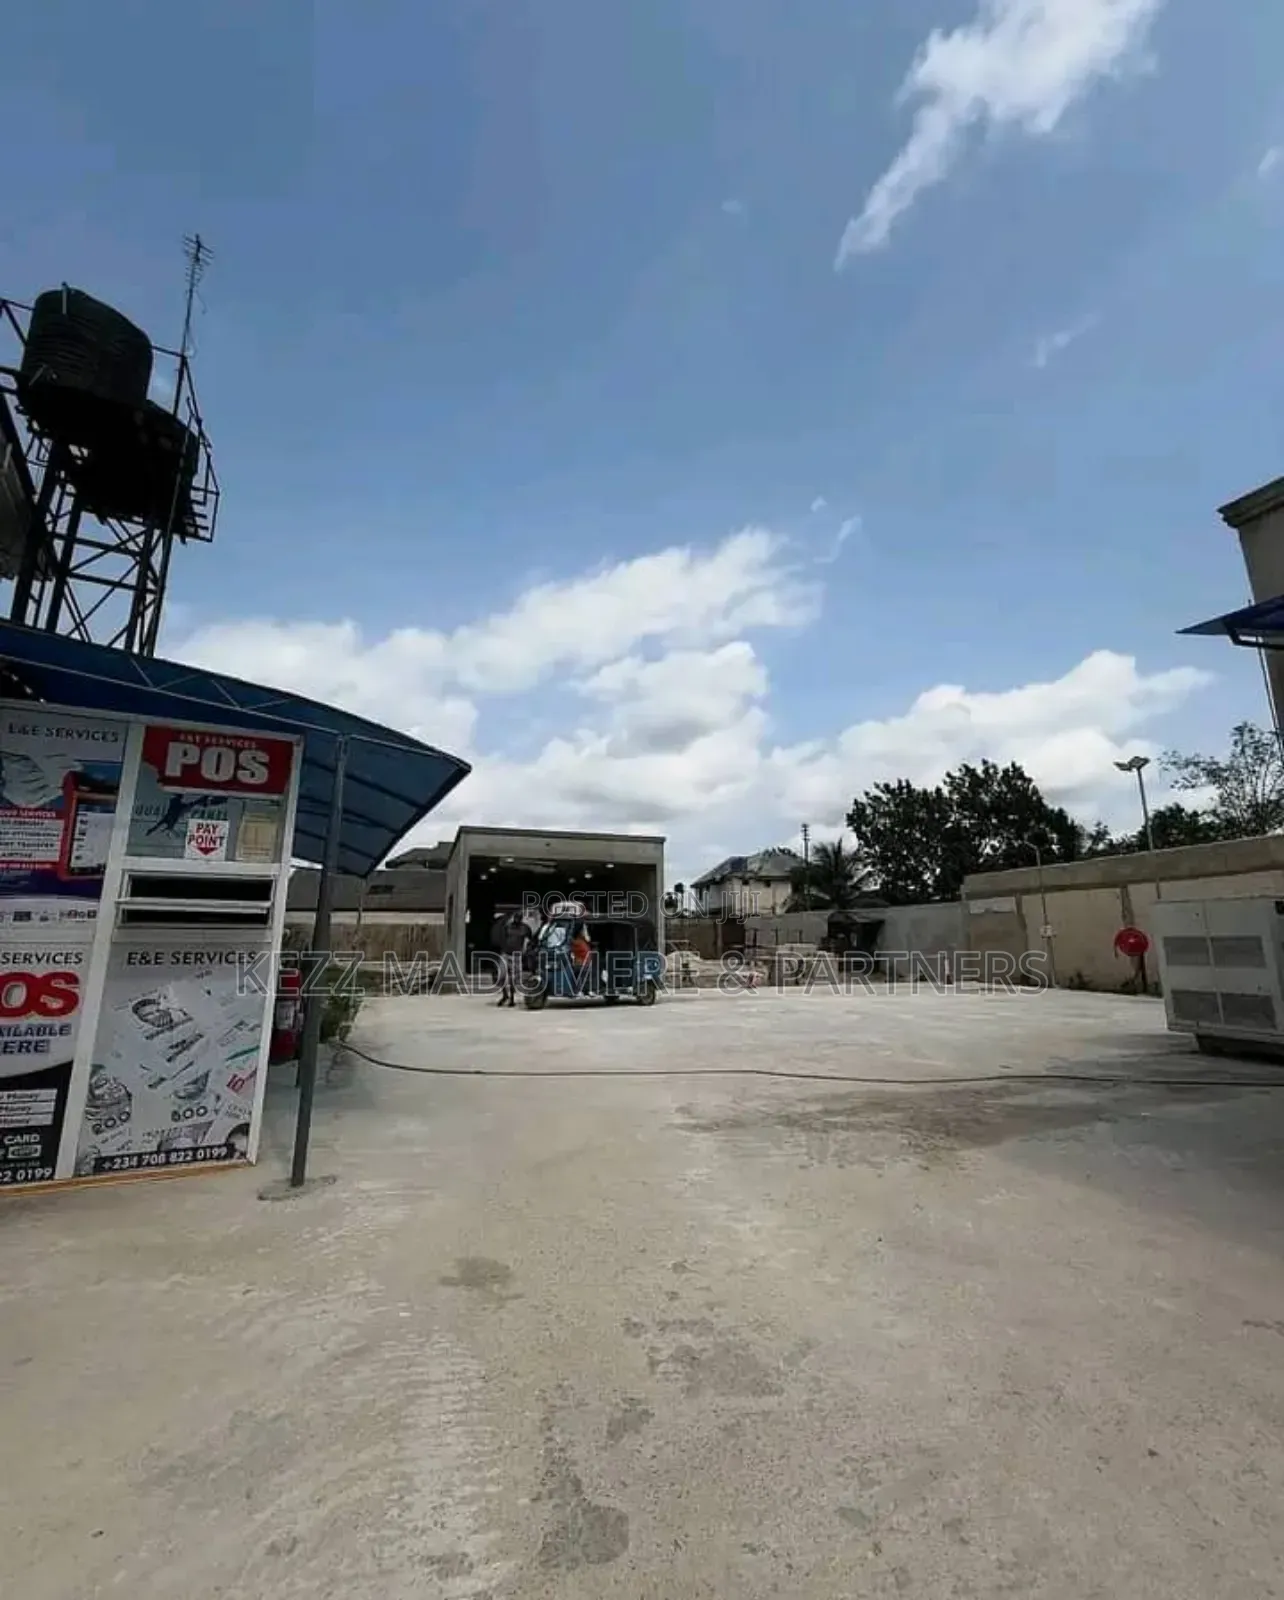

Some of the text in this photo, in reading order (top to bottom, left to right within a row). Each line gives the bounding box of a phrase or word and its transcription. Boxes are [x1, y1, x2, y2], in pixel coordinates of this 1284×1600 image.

[45, 727, 119, 743] SERVICES
[165, 741, 270, 785] POS
[196, 823, 219, 834] PAY
[187, 835, 226, 847] POINT
[1, 951, 83, 965] SERVICES
[126, 951, 257, 966] E&E SERVICES
[0, 1040, 50, 1055] ERE
[3, 1133, 40, 1145] CARD
[102, 1157, 138, 1170] +234
[196, 1146, 228, 1160] 0199
[16, 1167, 53, 1180] 0199
